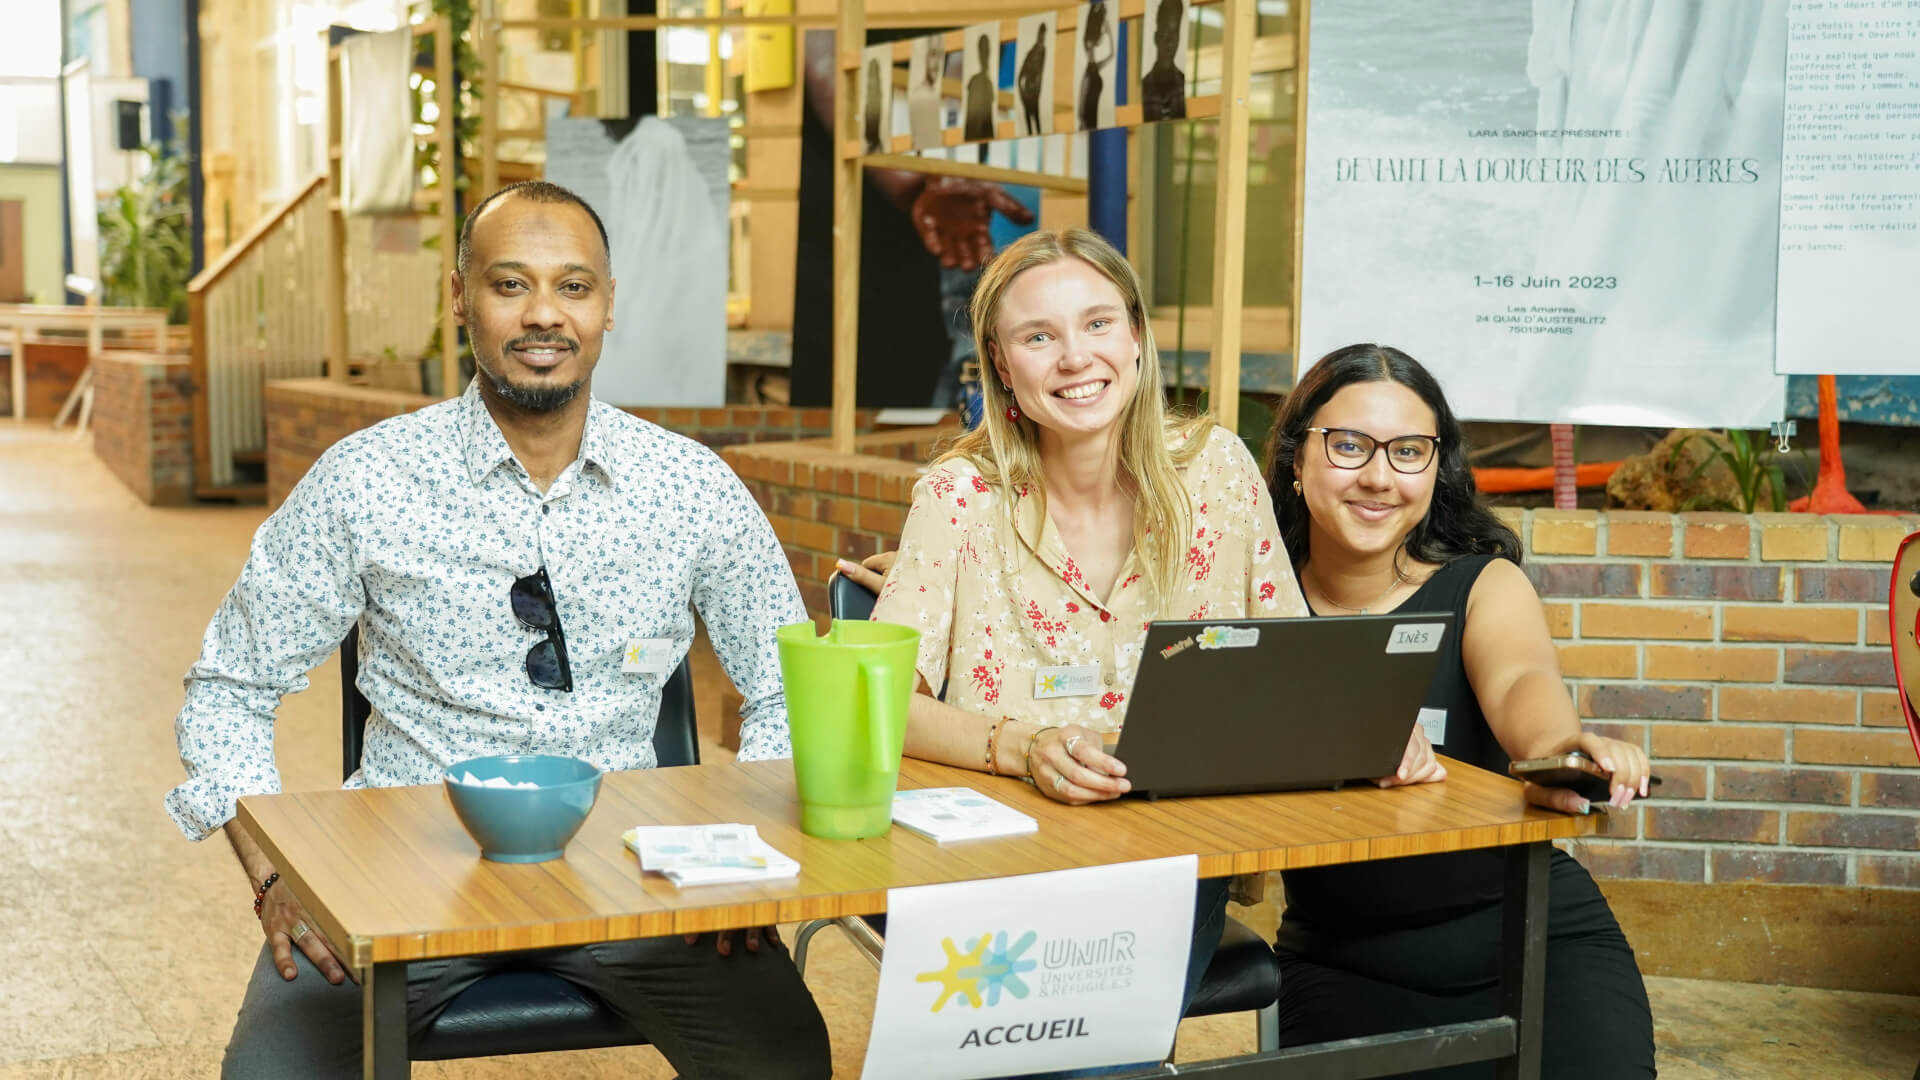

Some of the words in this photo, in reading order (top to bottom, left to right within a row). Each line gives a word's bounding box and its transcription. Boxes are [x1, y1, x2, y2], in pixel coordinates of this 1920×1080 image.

[1468, 129, 1498, 138] LARA
[1502, 129, 1558, 138] SANCHEZ
[1560, 127, 1622, 138] PRÉSENTE
[1336, 157, 1432, 183] DEVANT
[1438, 157, 1467, 183] LA
[1476, 157, 1586, 183] DOUCEUR
[1594, 157, 1646, 183] DES
[1658, 157, 1759, 184] AUTRES
[1520, 275, 1560, 288] Juin
[1568, 276, 1618, 289] 2023
[1530, 306, 1576, 314] Amarres
[1475, 315, 1489, 323] 24
[1492, 315, 1521, 324] QUAI
[1524, 315, 1606, 324] D'AUSTERLITZ
[1043, 930, 1136, 969] UNIR
[1040, 963, 1134, 985] UNIVERSITÉS
[959, 1016, 1090, 1049] ACCUEIL
